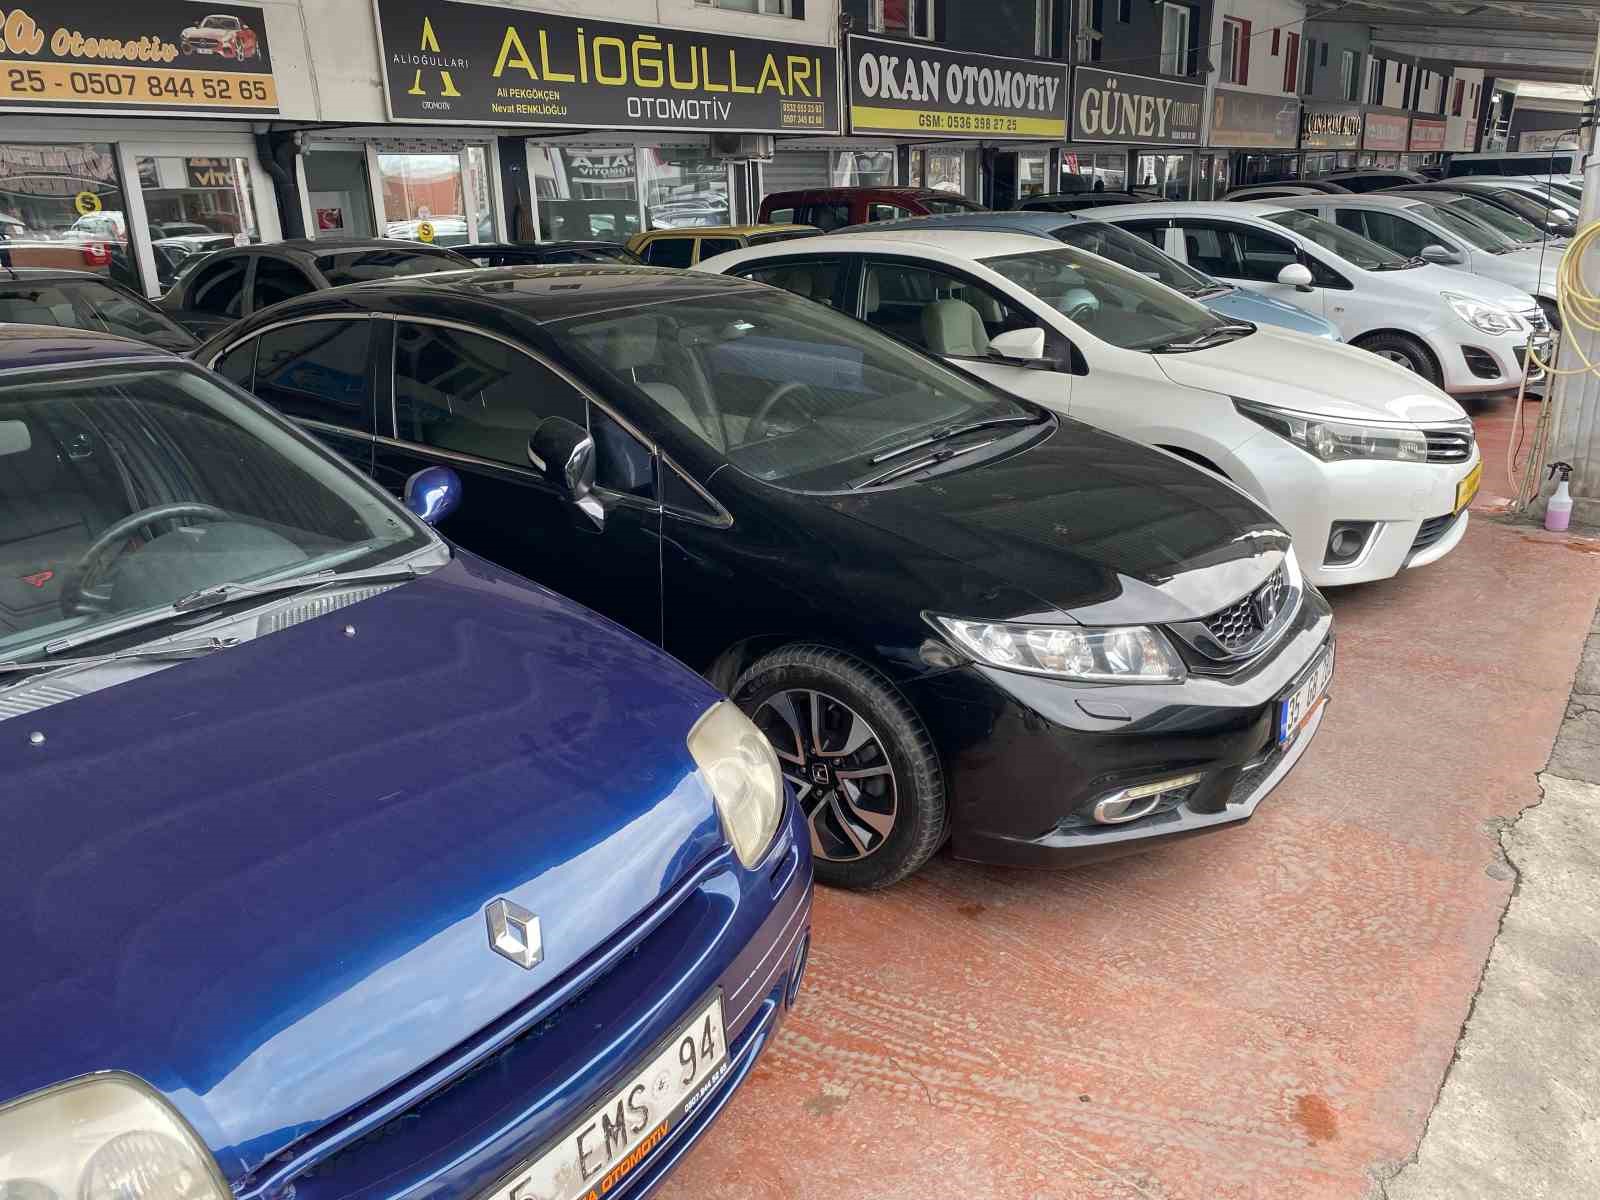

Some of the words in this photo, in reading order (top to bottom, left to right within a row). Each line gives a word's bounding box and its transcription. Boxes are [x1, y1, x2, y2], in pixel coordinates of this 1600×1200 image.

[51, 28, 178, 62] Otomotiv
[490, 26, 821, 97] ALİOĞULLARI
[8, 70, 45, 92] 25
[71, 72, 136, 96] 0507
[147, 76, 195, 98] 844
[202, 78, 232, 99] 52
[240, 80, 267, 101] 65
[858, 52, 941, 103] OKAN
[947, 115, 971, 129] 0536
[1079, 78, 1173, 137] GÜNEY
[576, 1084, 649, 1181] EMS
[679, 1014, 715, 1085] 94
